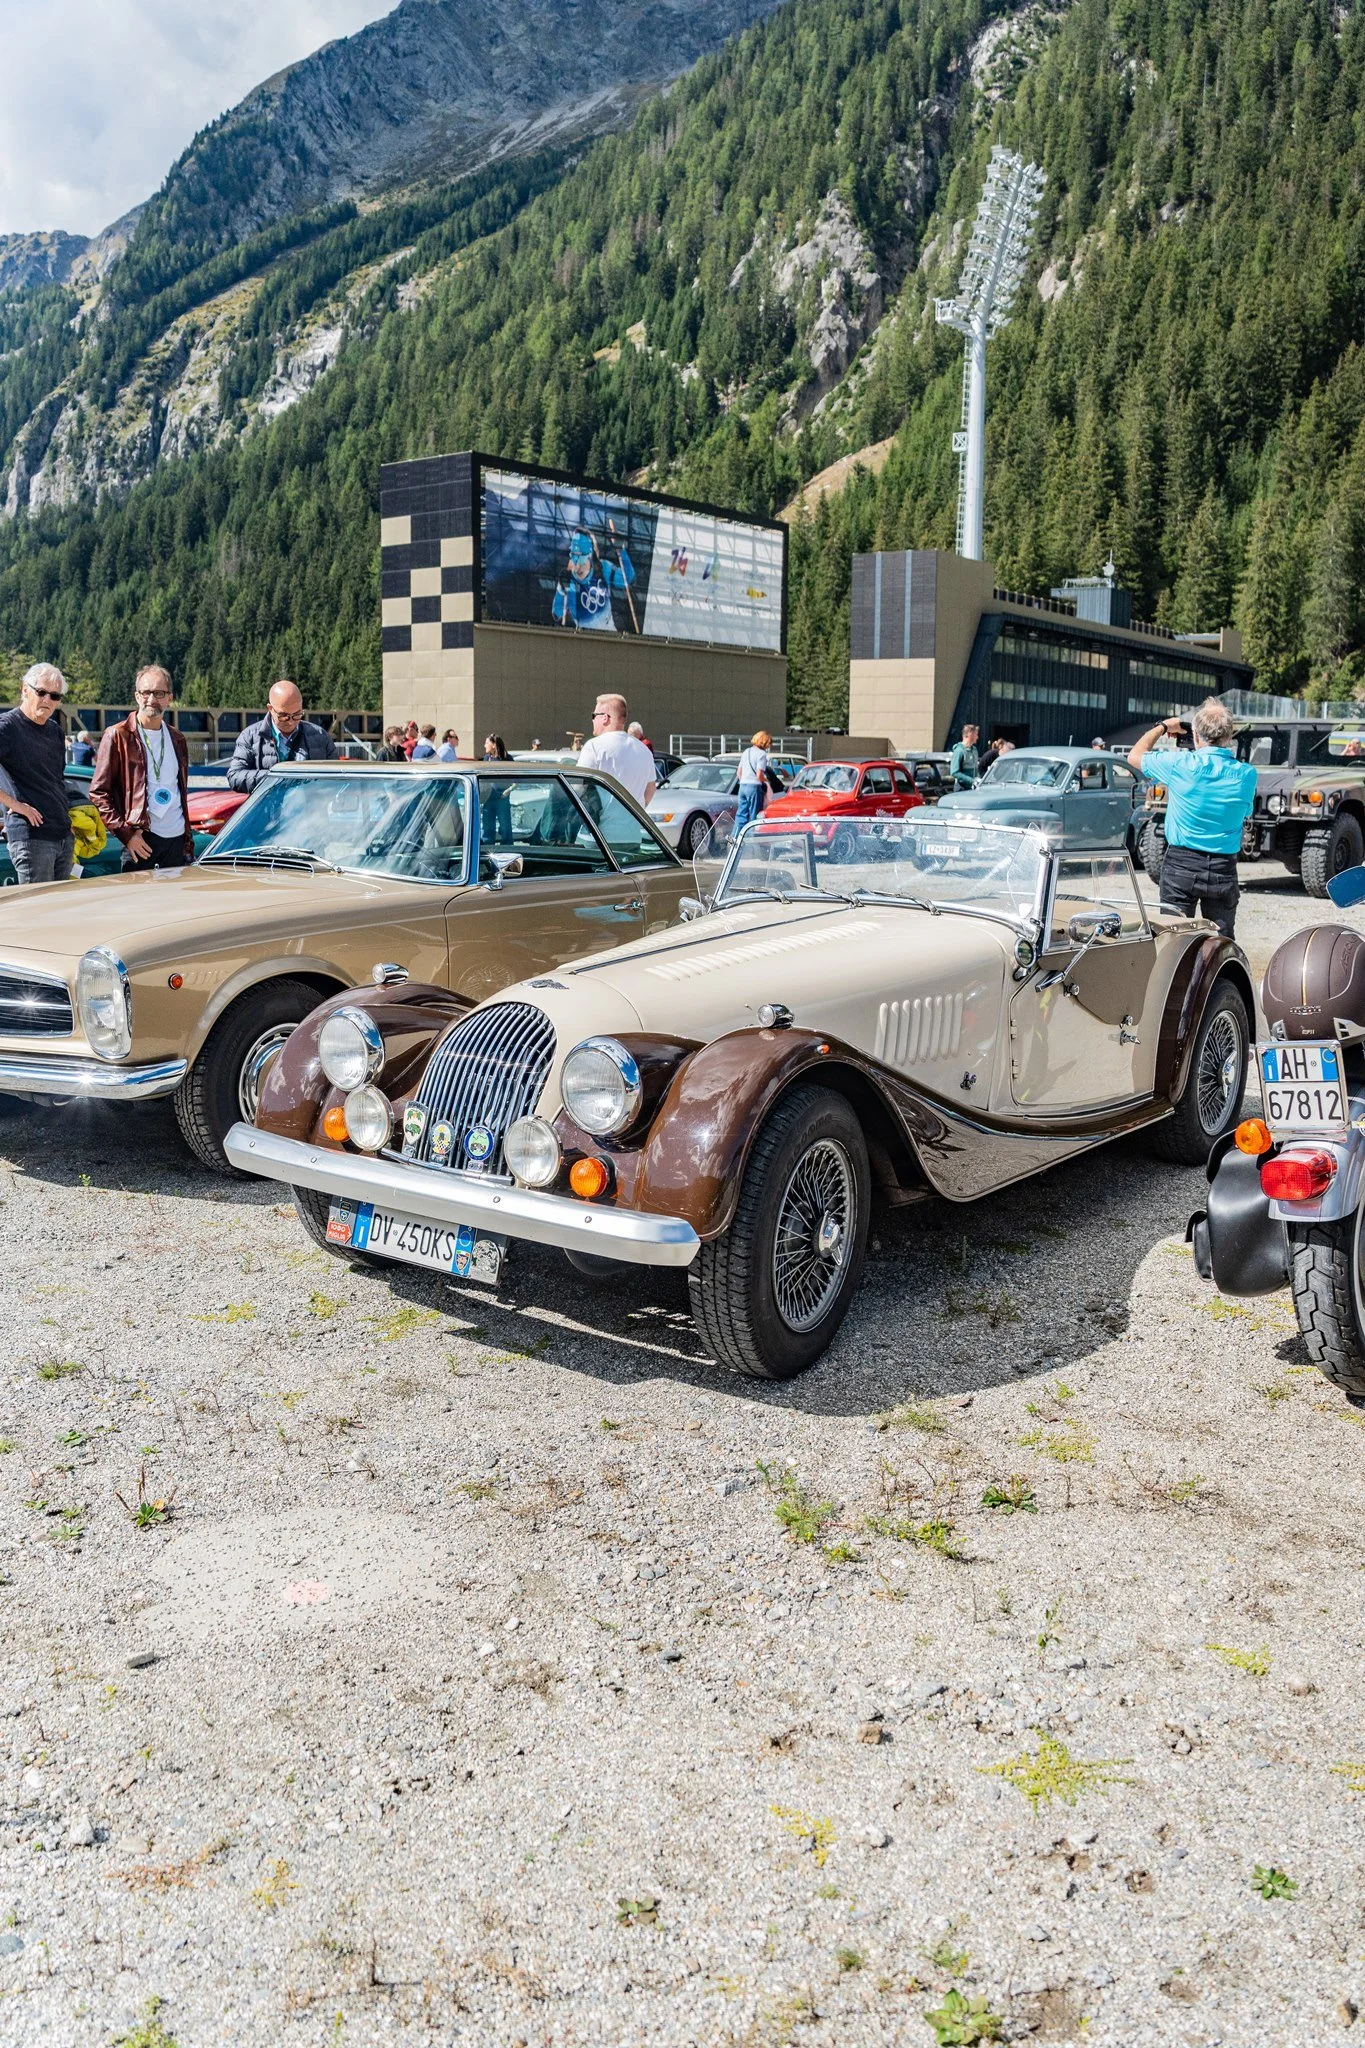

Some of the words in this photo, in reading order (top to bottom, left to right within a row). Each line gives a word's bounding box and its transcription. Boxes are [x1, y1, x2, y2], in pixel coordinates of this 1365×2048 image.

[1281, 1048, 1309, 1080] AH
[1268, 1089, 1342, 1121] 67812
[396, 1221, 456, 1261] 450KS
